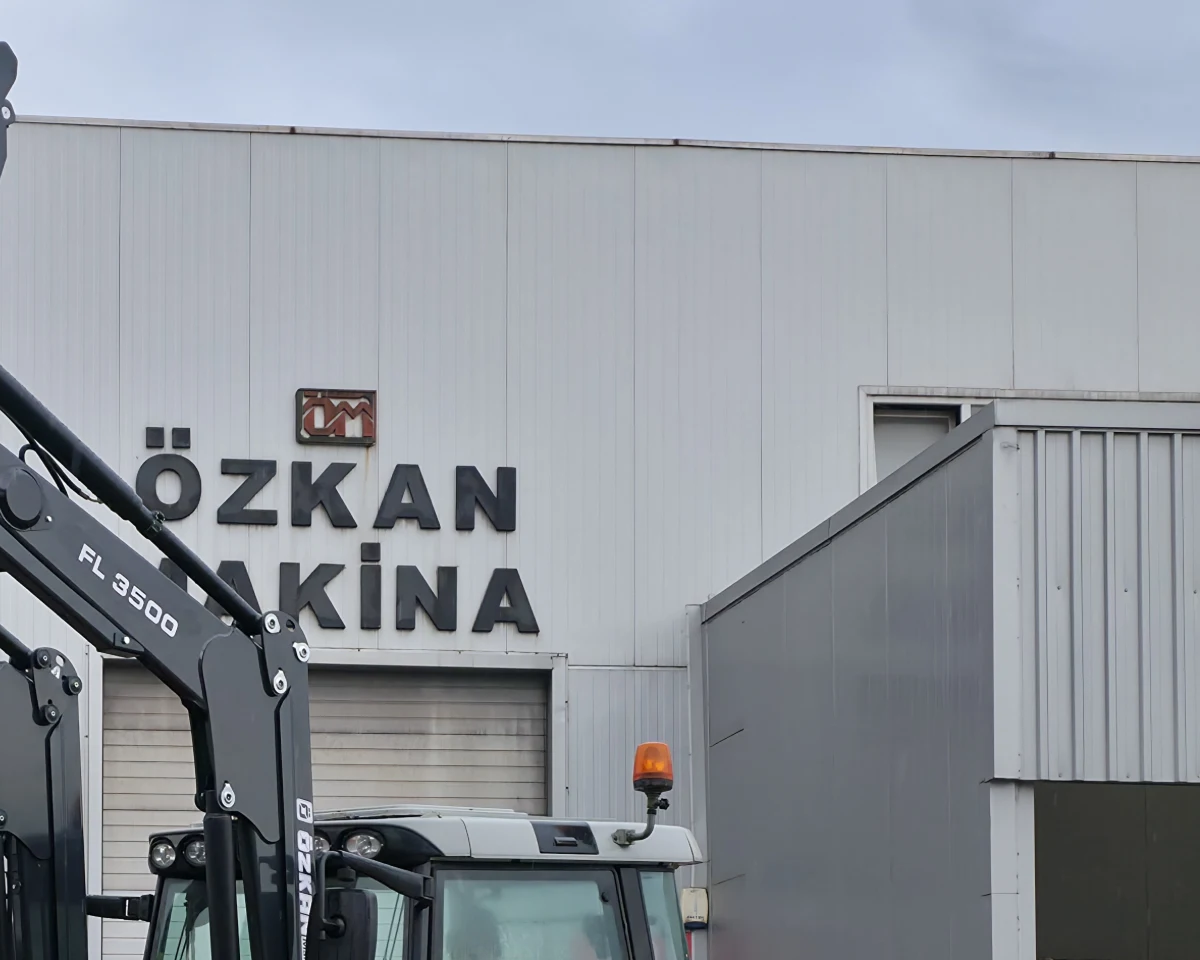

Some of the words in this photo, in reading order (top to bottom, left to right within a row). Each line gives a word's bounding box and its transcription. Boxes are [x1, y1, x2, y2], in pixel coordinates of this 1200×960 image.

[135, 426, 517, 532] ÖZKAN
[78, 543, 105, 580] FL
[112, 572, 179, 638] 3500
[158, 542, 540, 634] AKİNA
